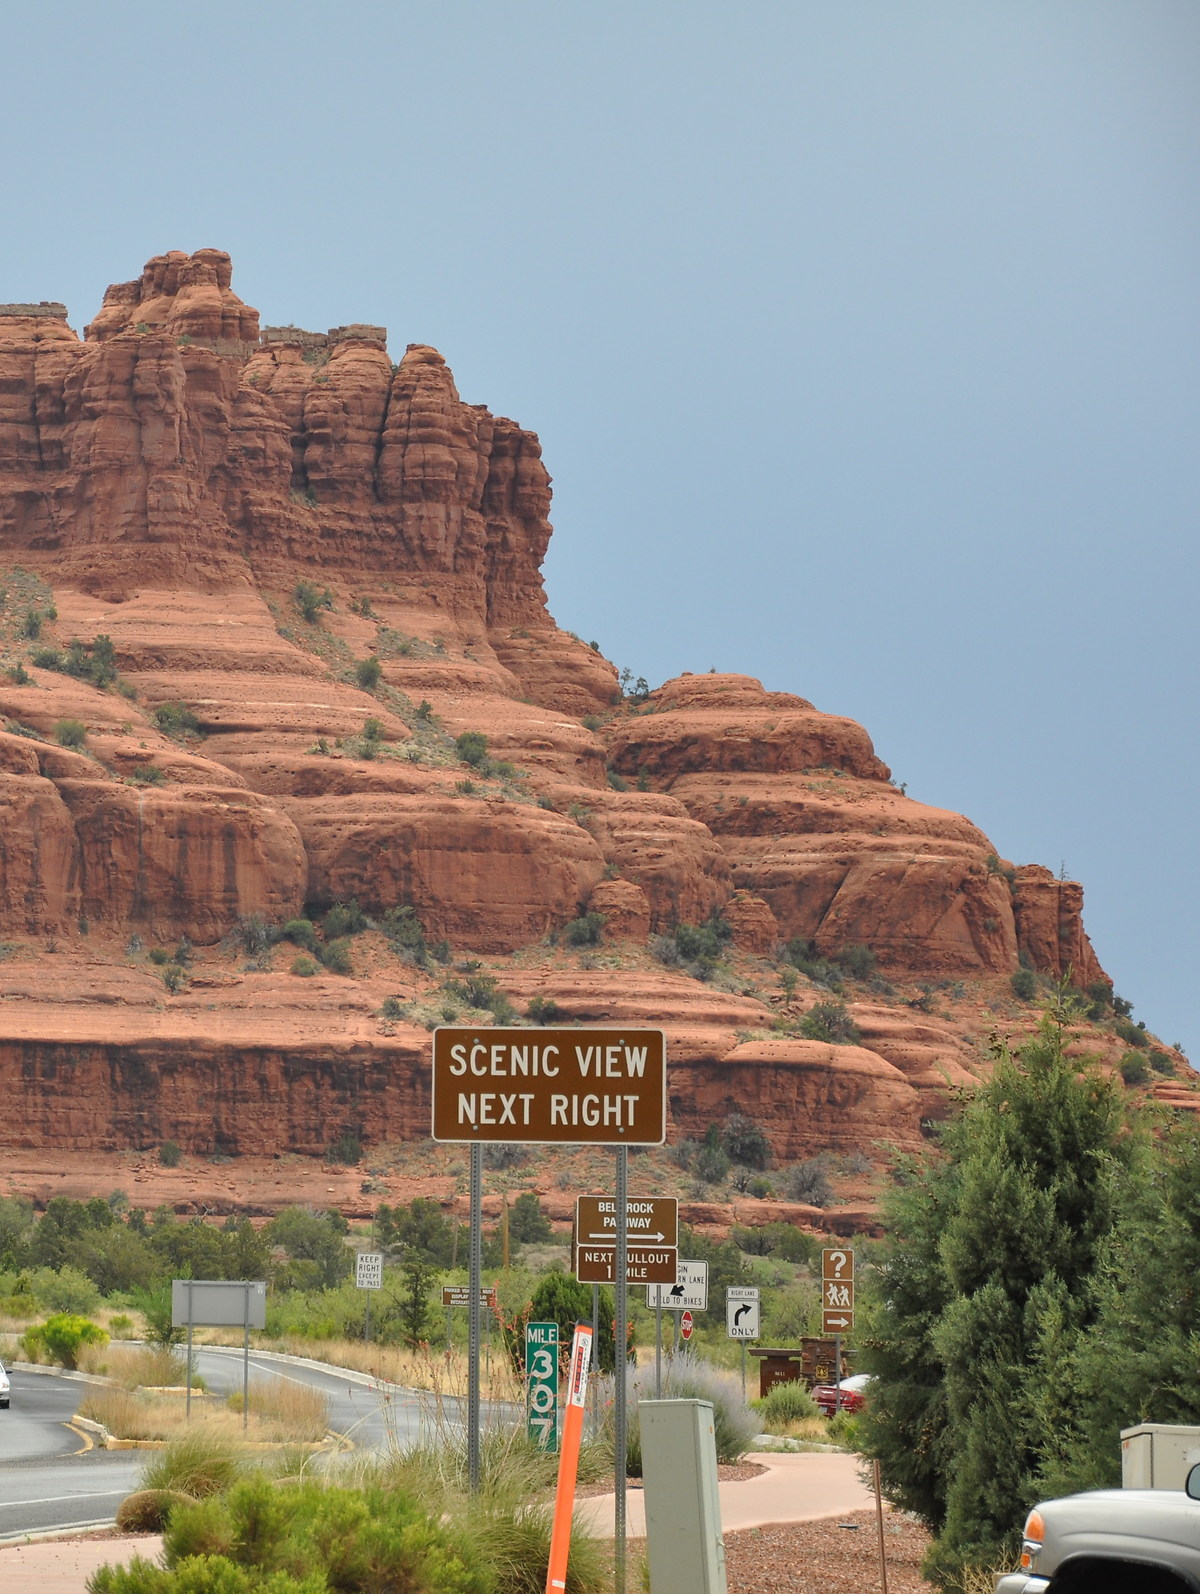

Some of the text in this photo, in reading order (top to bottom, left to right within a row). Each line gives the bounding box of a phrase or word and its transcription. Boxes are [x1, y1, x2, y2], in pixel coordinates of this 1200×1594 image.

[449, 1044, 648, 1078] SCENIC VIEW
[457, 1093, 640, 1127] NEXT RIGHT
[598, 1202, 654, 1214] BEL ROCK
[603, 1216, 652, 1229] PAWAY
[585, 1252, 670, 1264] NEXT ULLOUT
[359, 1264, 379, 1272] RIGHT
[606, 1264, 612, 1279] 1
[677, 1264, 688, 1274] GIN
[677, 1275, 705, 1284] RN LANE
[673, 1296, 681, 1305] TO
[683, 1297, 702, 1306] BIKES
[527, 1328, 557, 1344] MILE
[731, 1327, 755, 1336] ONLY
